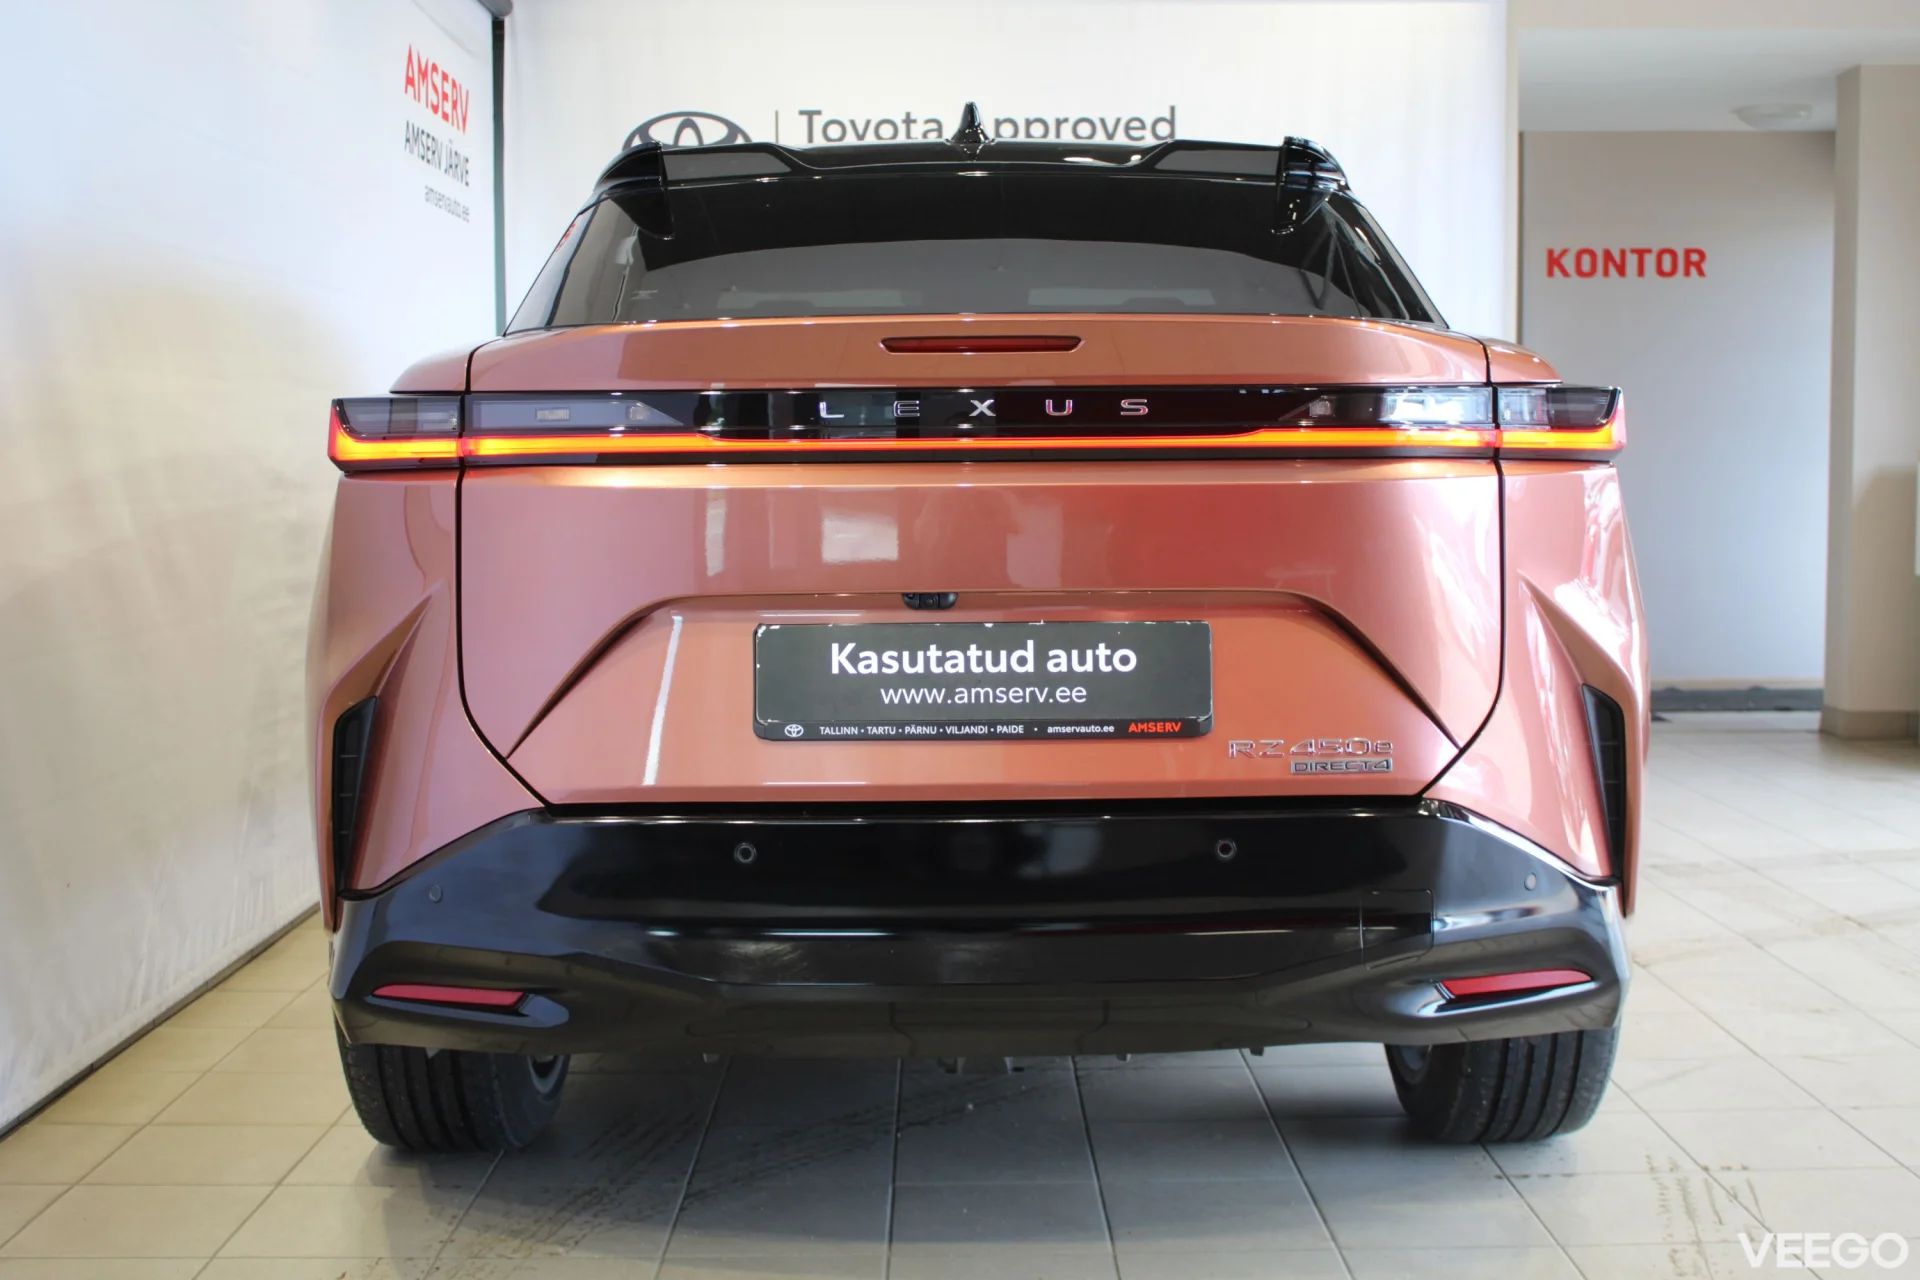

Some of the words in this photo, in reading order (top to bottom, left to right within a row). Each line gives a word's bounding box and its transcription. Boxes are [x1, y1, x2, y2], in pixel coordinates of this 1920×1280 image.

[404, 43, 469, 135] AMSERV
[993, 105, 1176, 142] pproved
[404, 119, 443, 171] AMSERV
[444, 138, 469, 187] JÄRVE
[1546, 248, 1707, 278] KONTOR
[819, 398, 1149, 417] LEXUS
[831, 639, 1034, 675] Kasutatud
[1046, 643, 1137, 673] auto
[880, 686, 1087, 704] www.amserv.ee
[819, 726, 858, 735] TALLINN
[866, 726, 896, 735] TARTU
[904, 724, 937, 735] PÄRNU
[945, 725, 988, 735] VILJANDI
[996, 724, 1024, 734] PAIDE
[1047, 724, 1115, 734] amservauto.ee
[1128, 721, 1182, 733] AMSERV
[1228, 739, 1285, 758] RZ
[1290, 737, 1393, 757] 450e
[1294, 759, 1391, 773] DIRECT4
